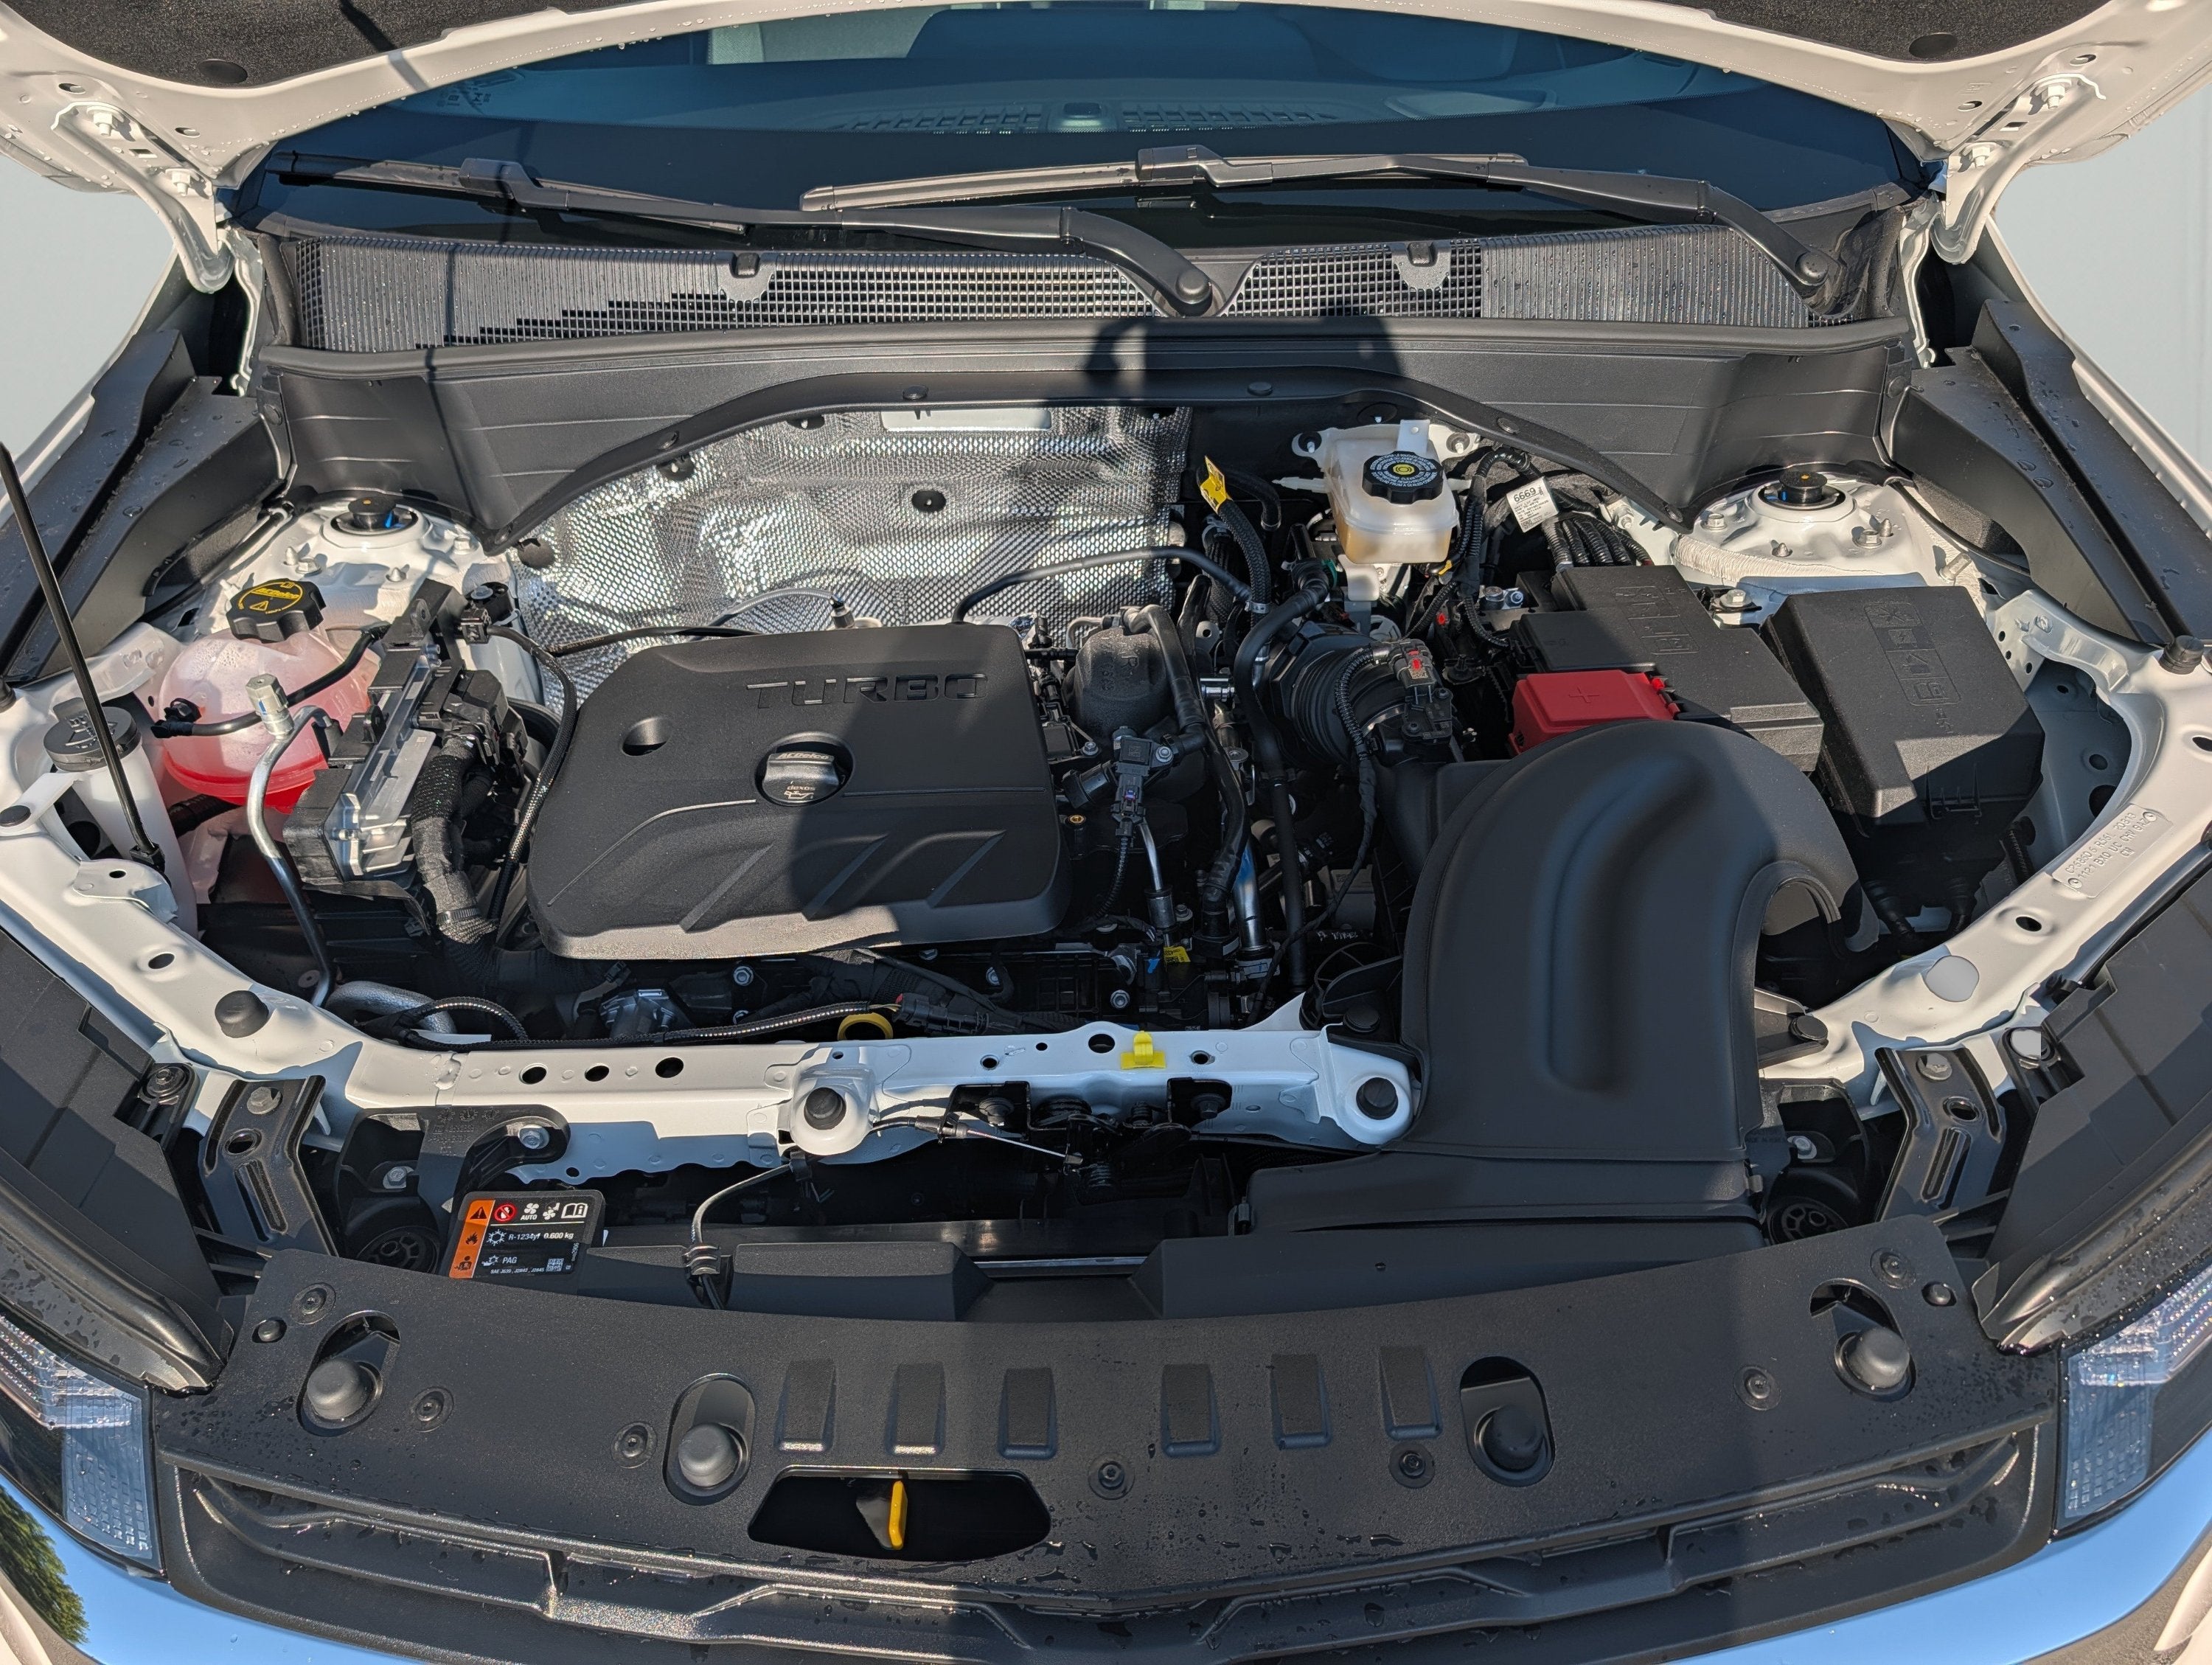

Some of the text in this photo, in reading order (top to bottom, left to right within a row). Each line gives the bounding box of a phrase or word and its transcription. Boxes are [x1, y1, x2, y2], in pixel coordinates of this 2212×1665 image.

[1513, 487, 1537, 503] 6669
[746, 673, 988, 709] TURBO
[777, 752, 830, 760] ACDelco
[2078, 863, 2098, 880] 1121
[508, 1232, 541, 1241] R-1234yf
